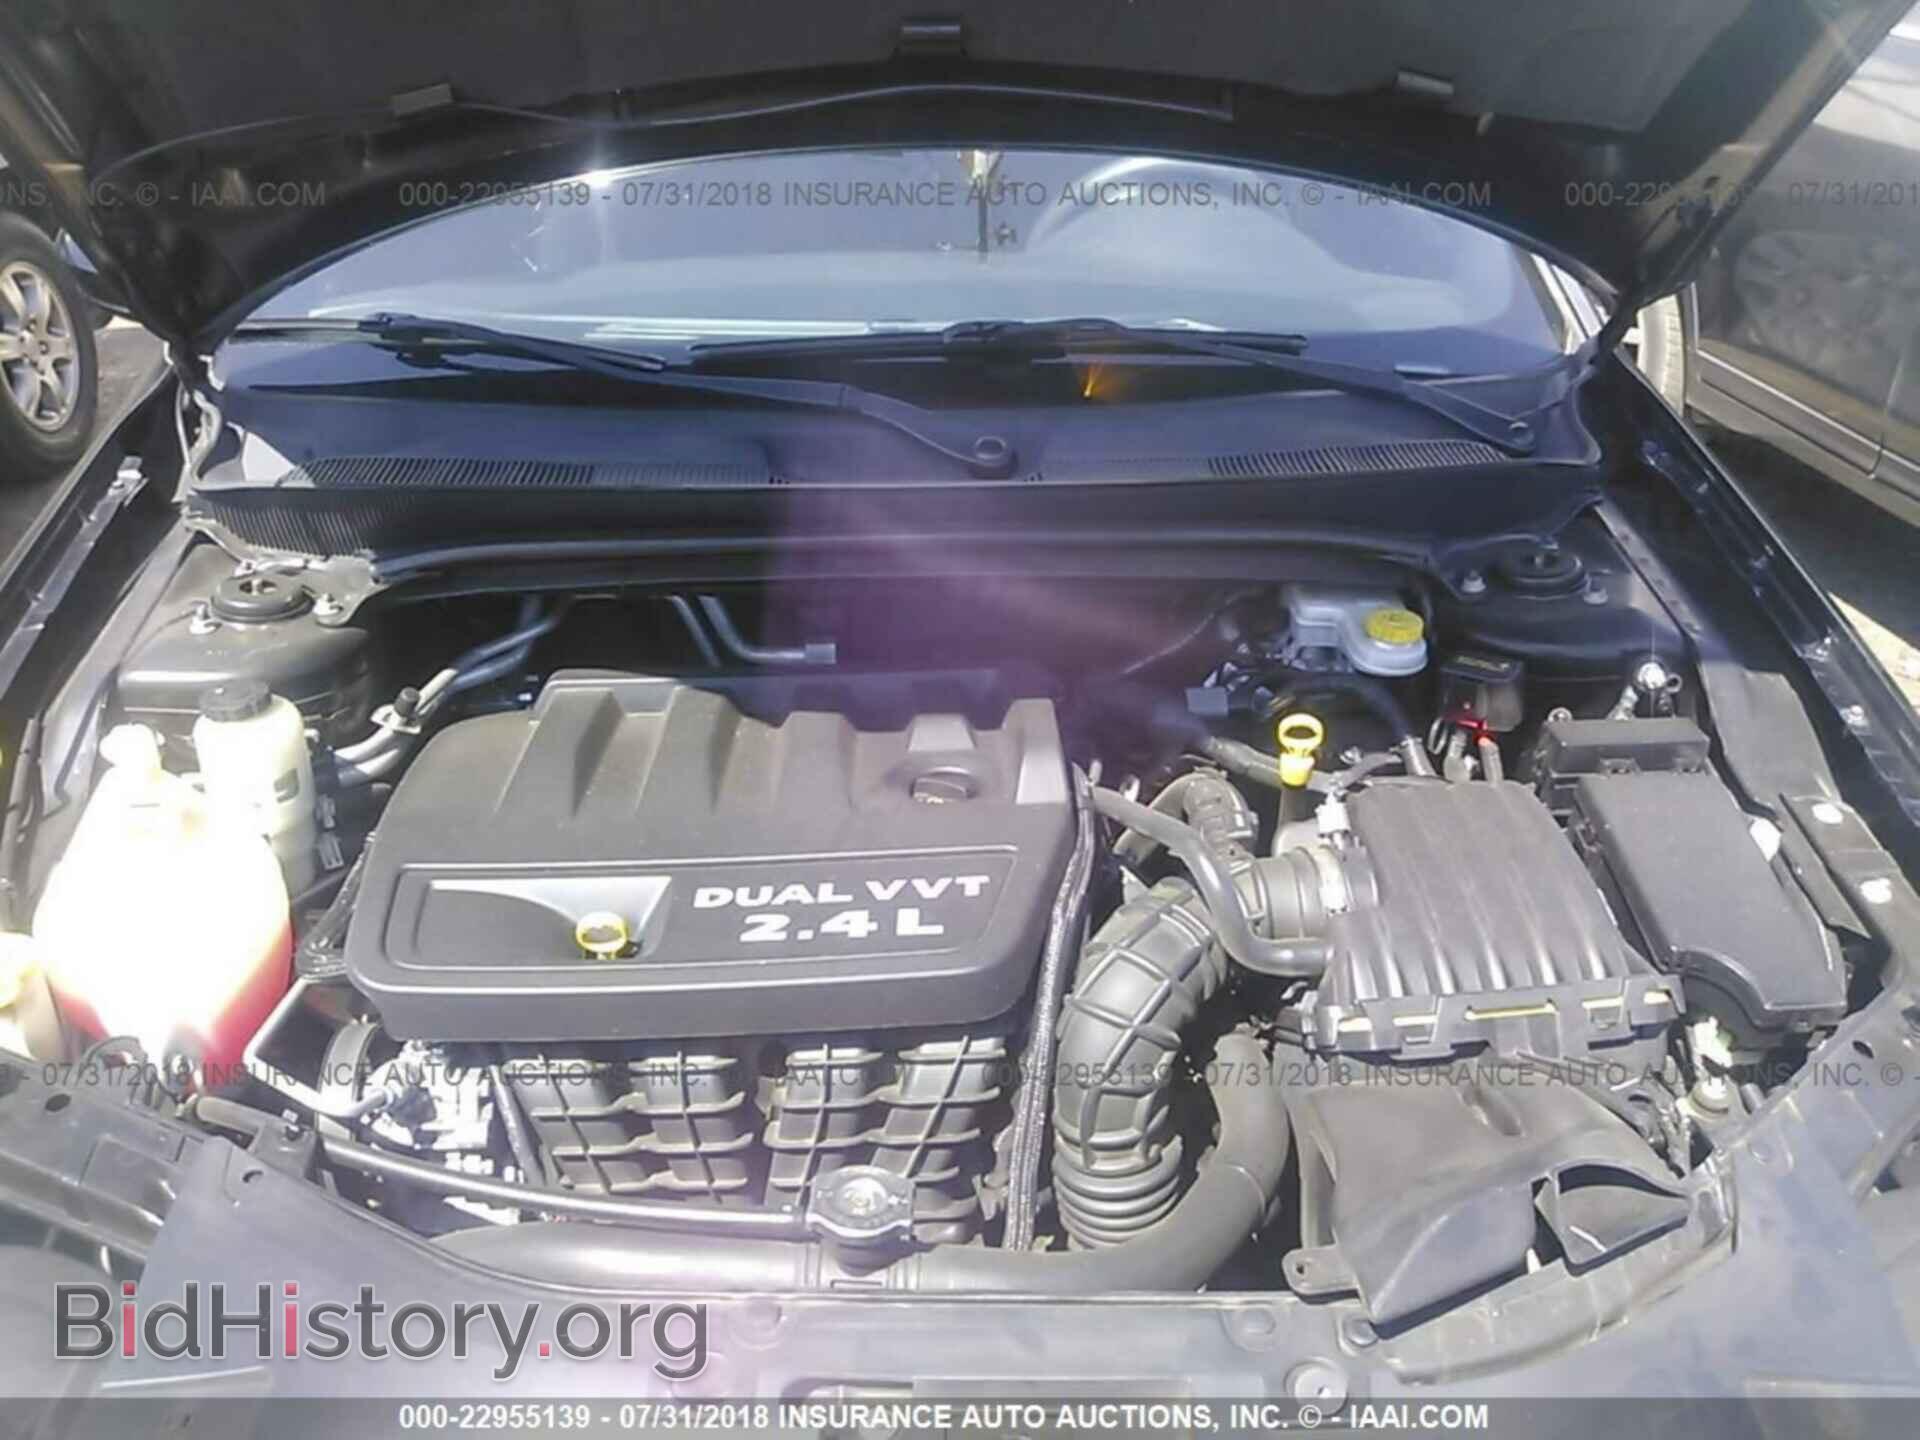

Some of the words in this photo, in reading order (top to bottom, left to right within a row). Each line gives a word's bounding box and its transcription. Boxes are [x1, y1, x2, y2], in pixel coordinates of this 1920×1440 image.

[693, 882, 853, 908] DUAL
[865, 875, 990, 901] VVT
[739, 909, 878, 942] 2.4
[896, 908, 944, 936] L
